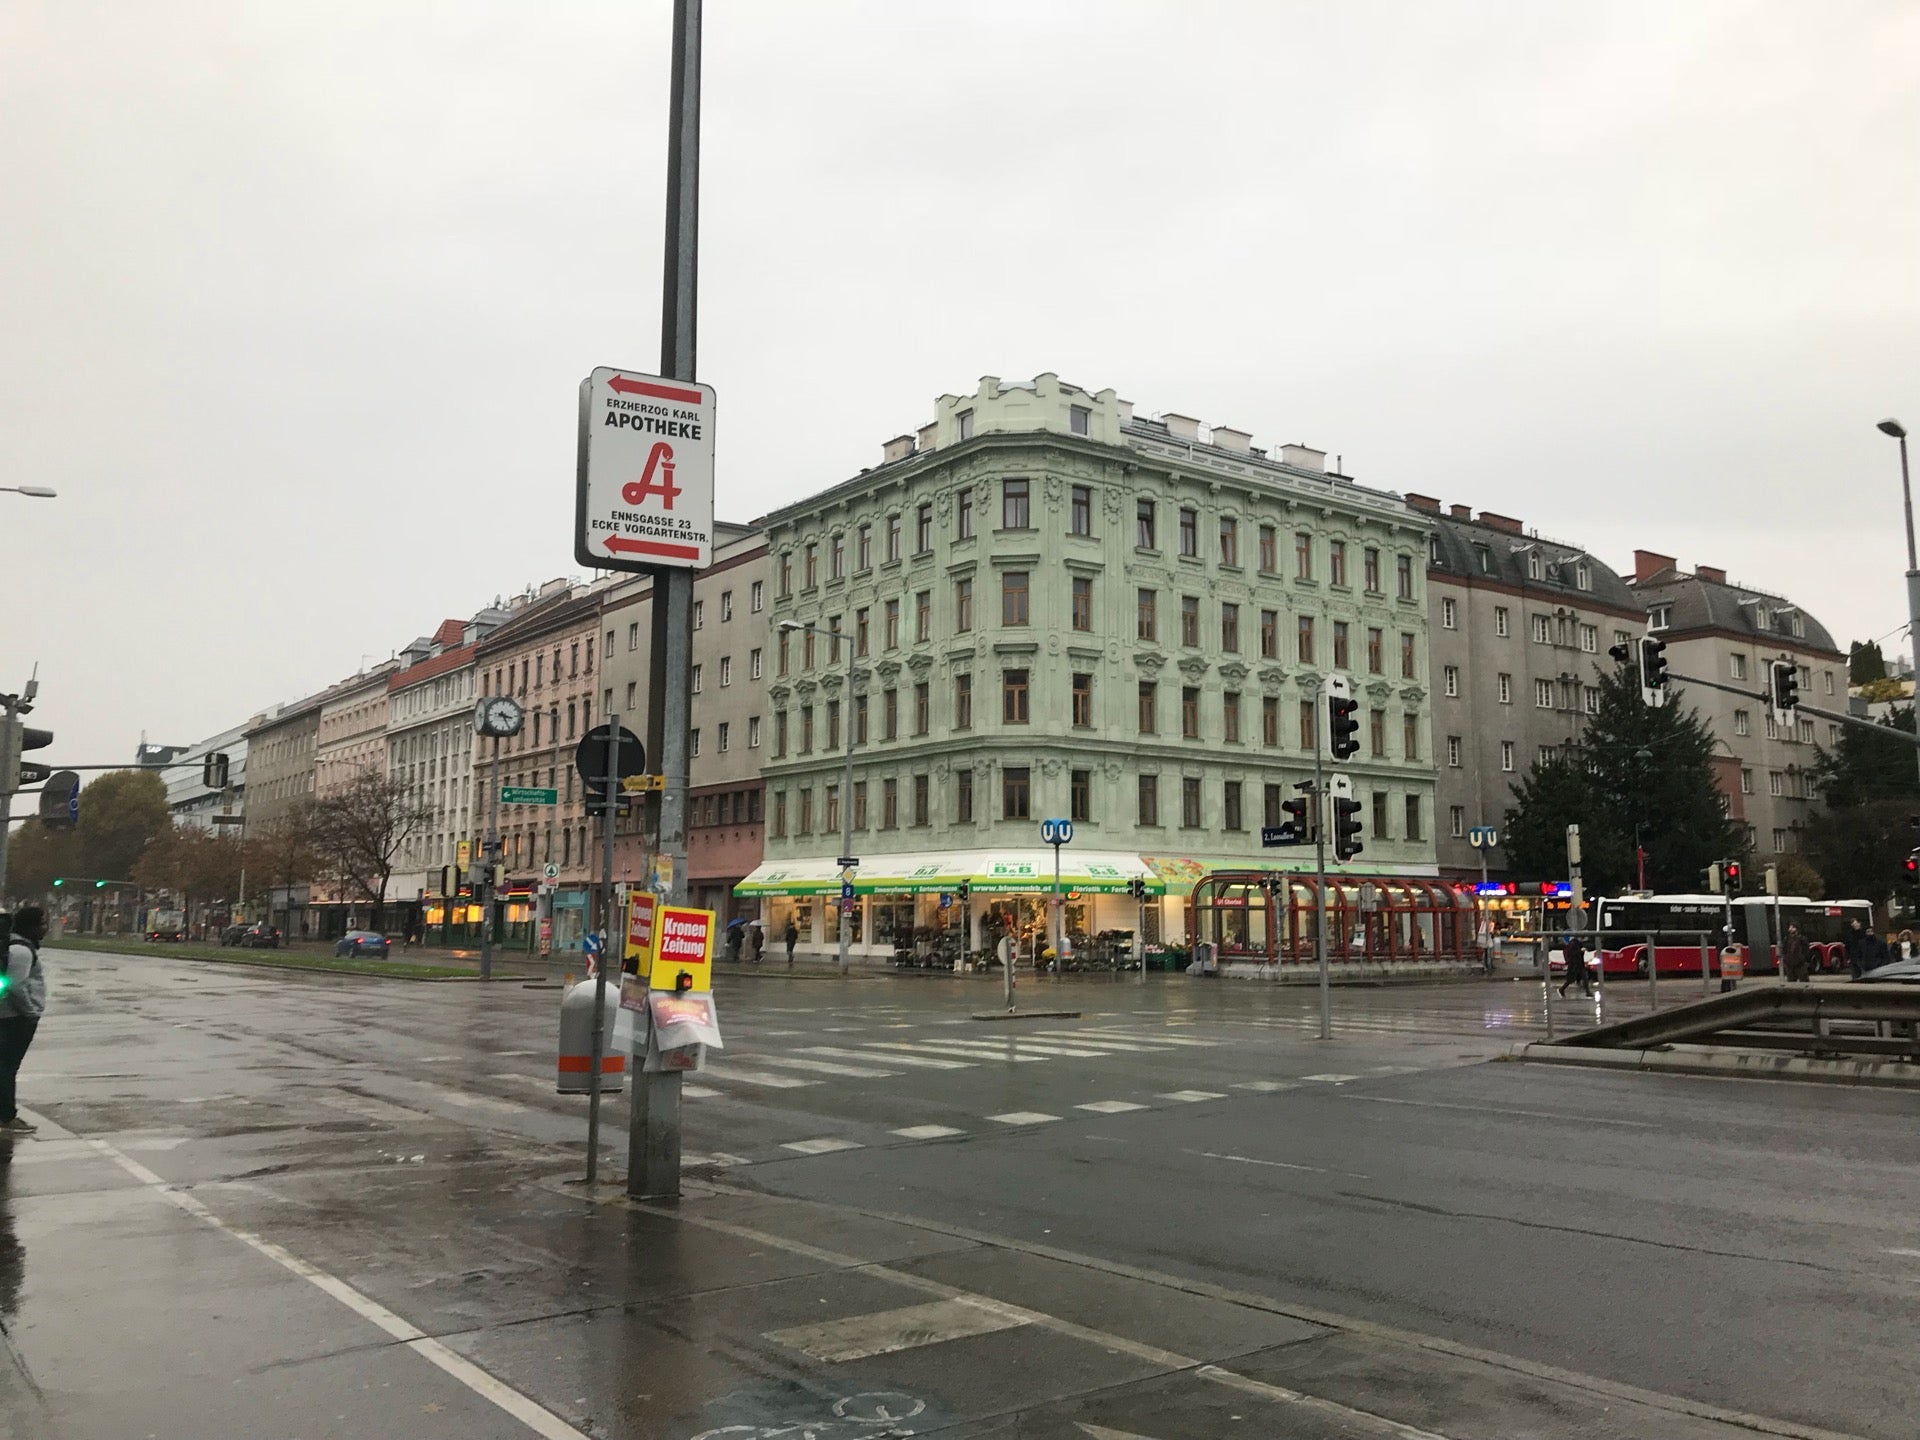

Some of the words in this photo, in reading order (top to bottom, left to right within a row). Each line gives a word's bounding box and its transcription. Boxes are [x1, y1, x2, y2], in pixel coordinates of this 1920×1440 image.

[606, 398, 669, 417] ERZHERZOG
[672, 408, 700, 422] KARL
[605, 411, 701, 440] APOTHEKE
[611, 510, 674, 527] ENNSGASSE
[678, 519, 692, 530] 23
[592, 519, 620, 532] ECKE
[624, 523, 709, 543] VORGARTENSTR.
[1042, 824, 1054, 842] U
[1058, 824, 1071, 842] U
[1470, 831, 1483, 847] U
[1487, 831, 1497, 847] U
[994, 866, 1032, 874] B&B
[972, 885, 1052, 893] www.blumenbb.at
[663, 917, 707, 938] Kronen
[661, 936, 705, 959] Zeitung
